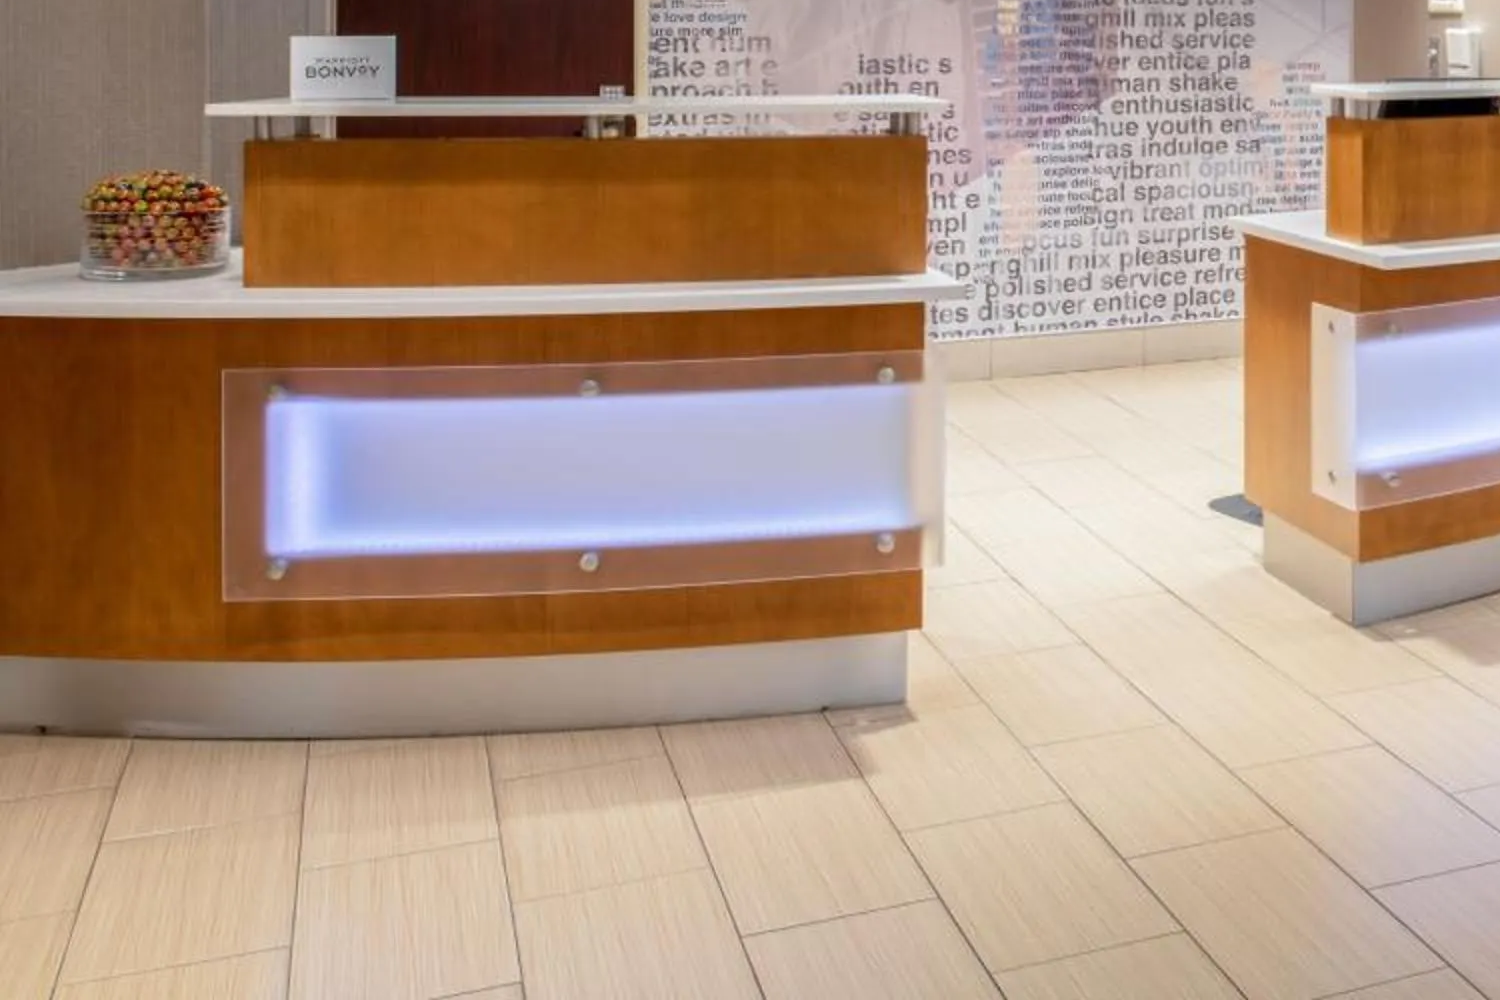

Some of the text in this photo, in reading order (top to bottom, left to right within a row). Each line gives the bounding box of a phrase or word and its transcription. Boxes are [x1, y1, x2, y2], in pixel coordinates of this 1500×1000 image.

[1144, 10, 1187, 28] mix
[1194, 7, 1257, 33] pleas
[1171, 30, 1257, 50] service
[857, 54, 930, 76] iastic
[1137, 52, 1210, 72] entice
[1217, 51, 1252, 73] pla
[1168, 73, 1238, 93] shake
[1110, 94, 1256, 115] enthusiastic
[1092, 115, 1139, 137] hue
[1146, 117, 1213, 140] youth
[1141, 137, 1229, 161] indulge
[1143, 200, 1196, 223] treat
[1138, 222, 1236, 246] surprise
[1067, 250, 1112, 271] mix
[1119, 246, 1222, 270] pleasure
[985, 272, 1092, 301] polished
[1101, 266, 1188, 290] service
[978, 298, 1083, 322] discover
[1093, 291, 1167, 314] entice
[1174, 285, 1236, 312] place
